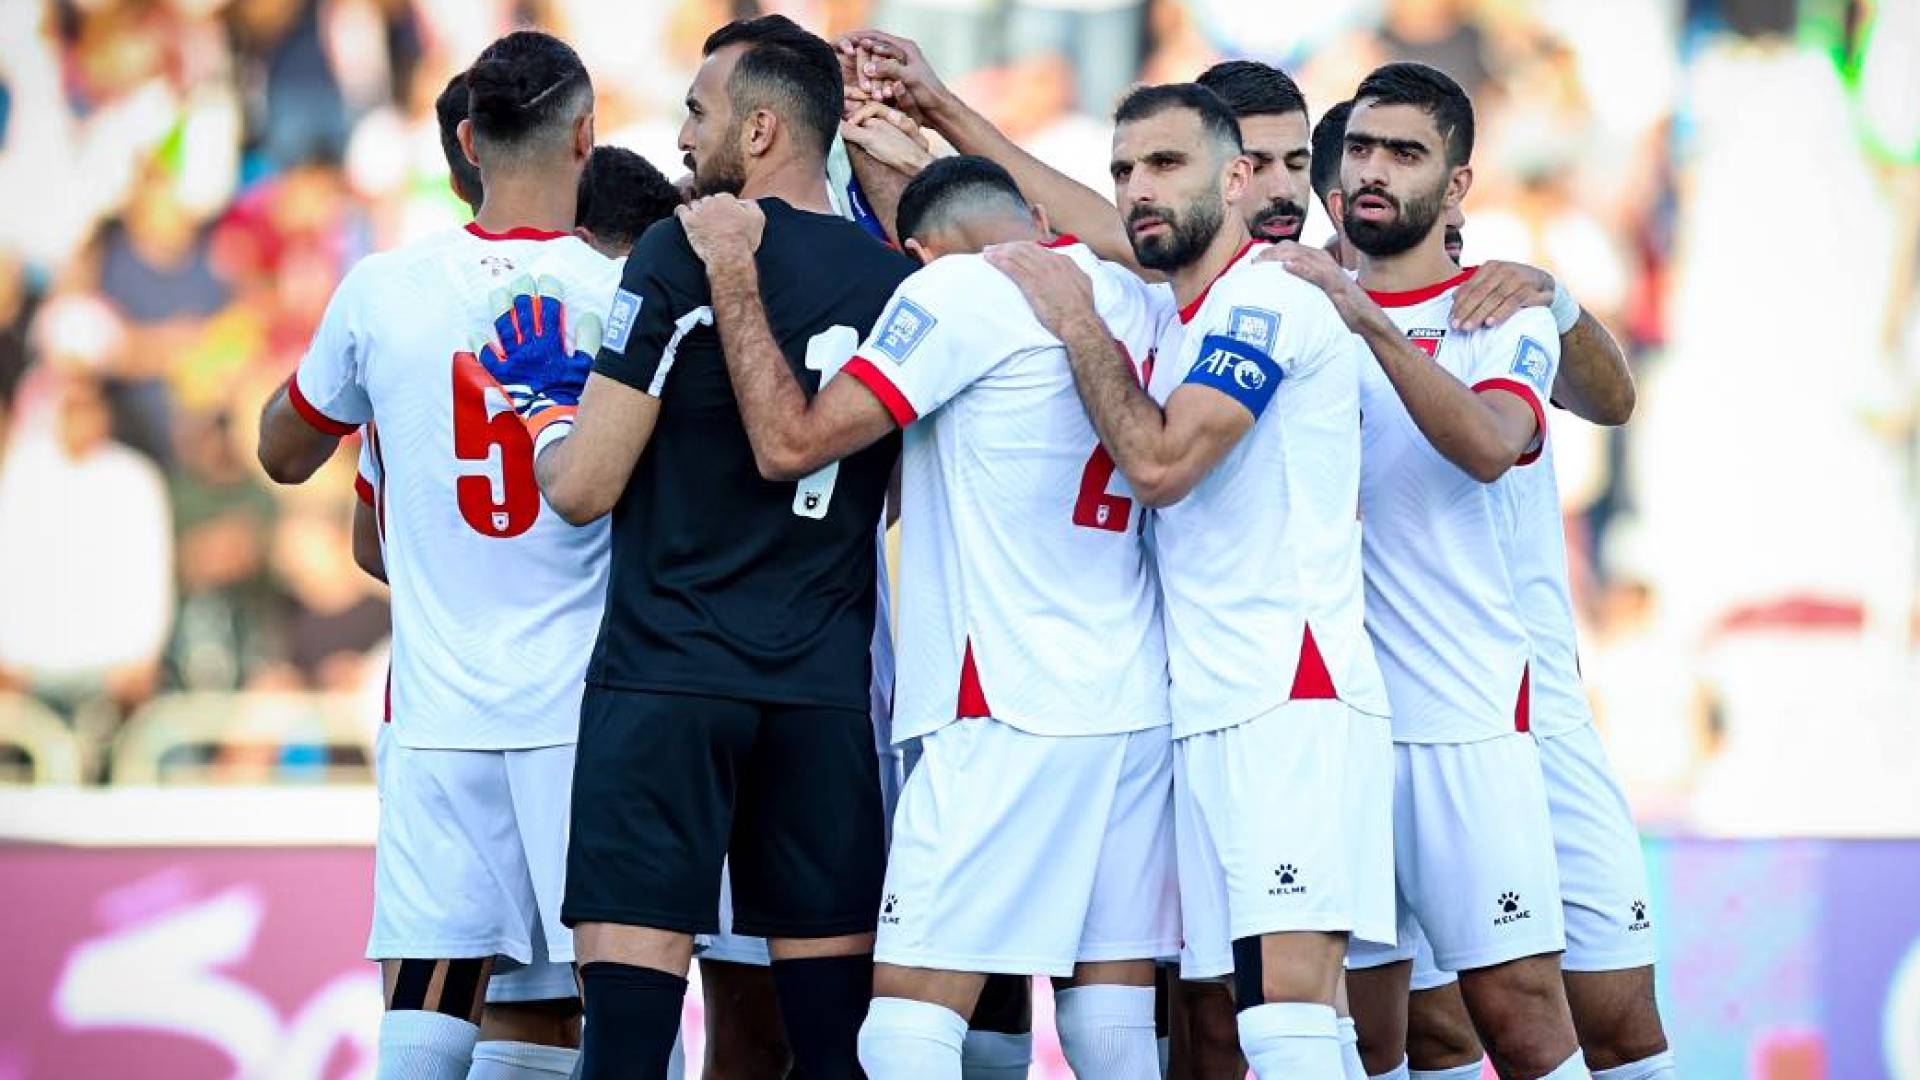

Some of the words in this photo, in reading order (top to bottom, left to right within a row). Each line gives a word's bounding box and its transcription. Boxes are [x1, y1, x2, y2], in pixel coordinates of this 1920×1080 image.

[1192, 349, 1266, 390] AFC
[792, 324, 860, 520] 1
[453, 352, 541, 538] 5
[1268, 886, 1307, 896] KELME
[1493, 910, 1531, 926] KELME
